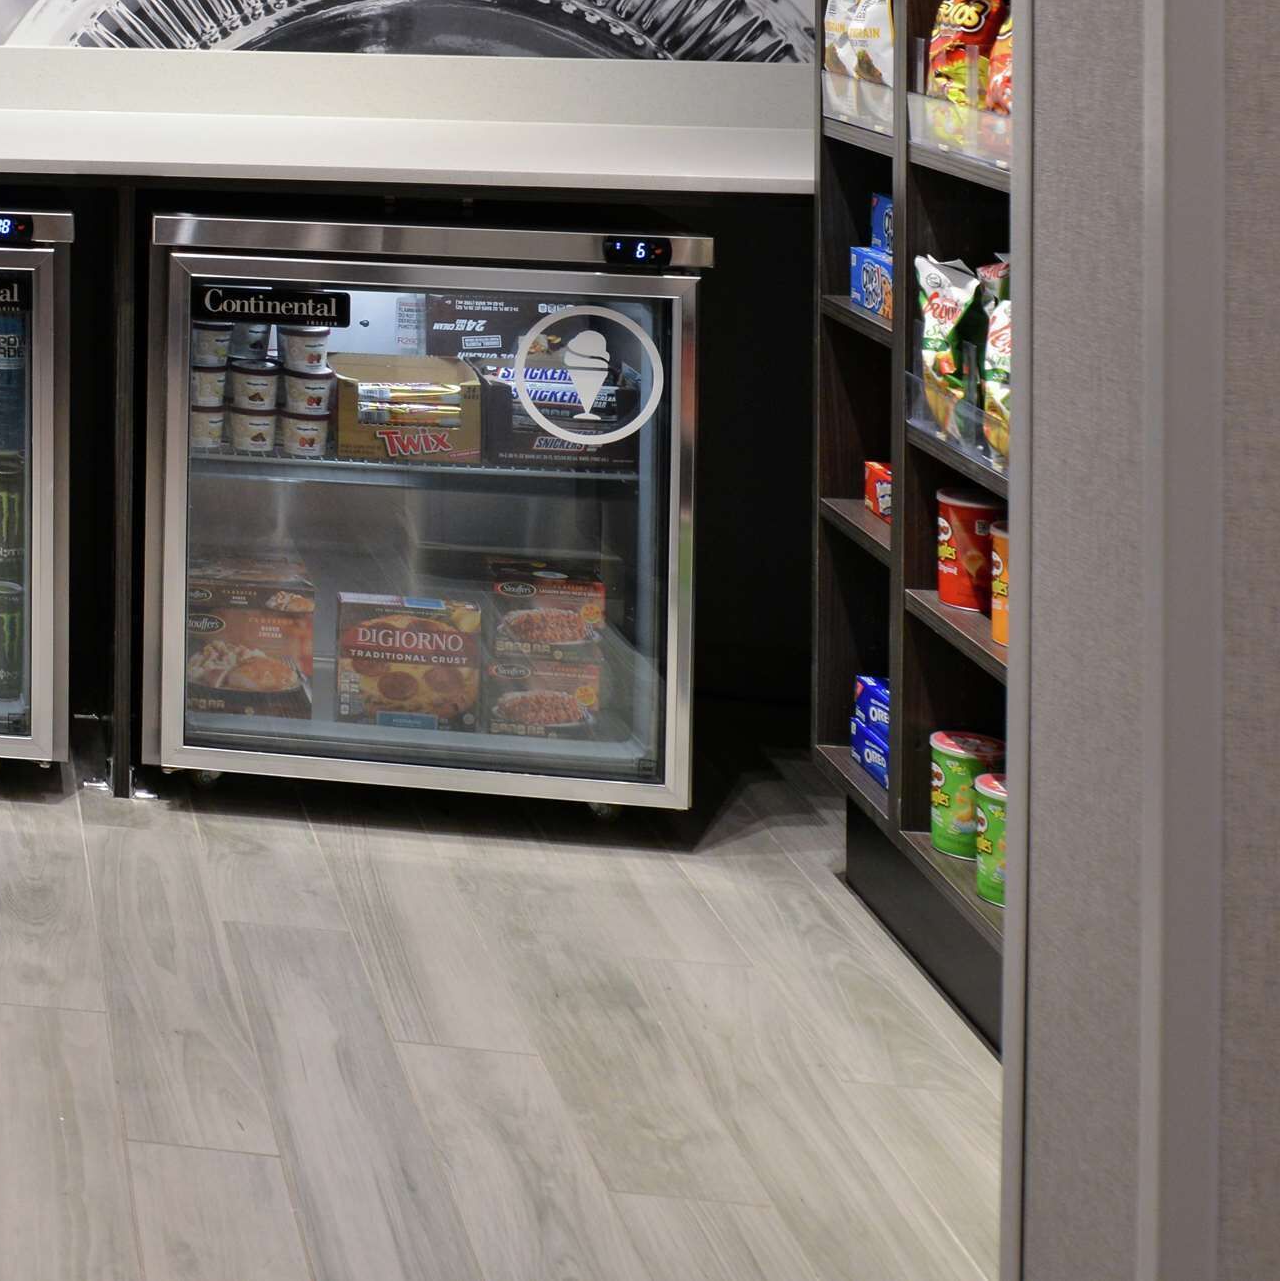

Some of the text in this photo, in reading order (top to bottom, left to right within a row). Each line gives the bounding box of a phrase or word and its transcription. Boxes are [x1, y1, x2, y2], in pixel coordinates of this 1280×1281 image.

[635, 243, 646, 259] 6
[204, 289, 337, 317] Continental
[502, 367, 572, 382] SICKER
[378, 429, 452, 457] Twix
[349, 649, 468, 665] TRADITIONAL CRUST
[864, 746, 887, 769] OREO
